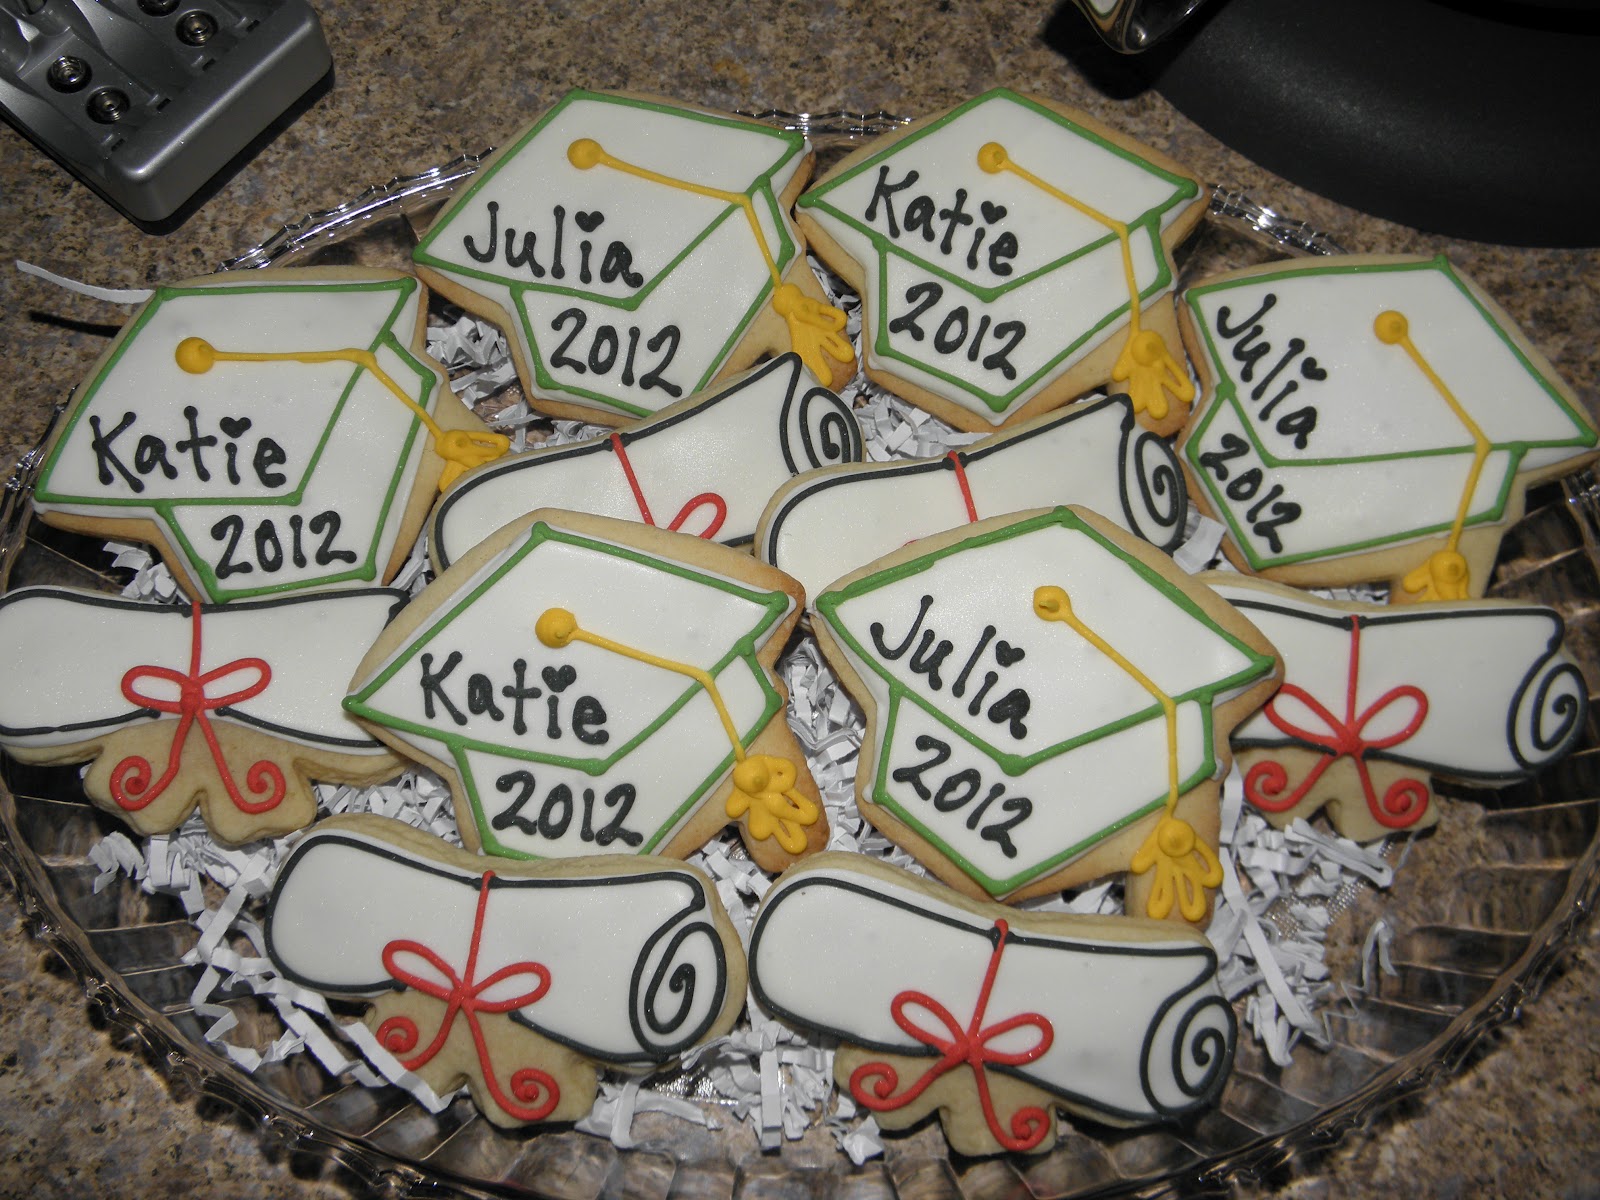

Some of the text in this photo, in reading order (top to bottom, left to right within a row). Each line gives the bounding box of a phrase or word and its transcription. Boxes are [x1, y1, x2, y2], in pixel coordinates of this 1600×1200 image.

[464, 200, 644, 289] Julia
[865, 164, 1019, 277] Katie
[550, 307, 682, 396] 2012
[888, 281, 1027, 381] 2012
[1216, 293, 1328, 450] Julia
[89, 405, 287, 494] Katie
[1200, 433, 1302, 556] 2012
[211, 510, 358, 580] 2012
[420, 650, 610, 746] Katie
[869, 594, 1031, 740] Julia
[492, 770, 644, 849] 2012
[893, 734, 1033, 860] 2012
